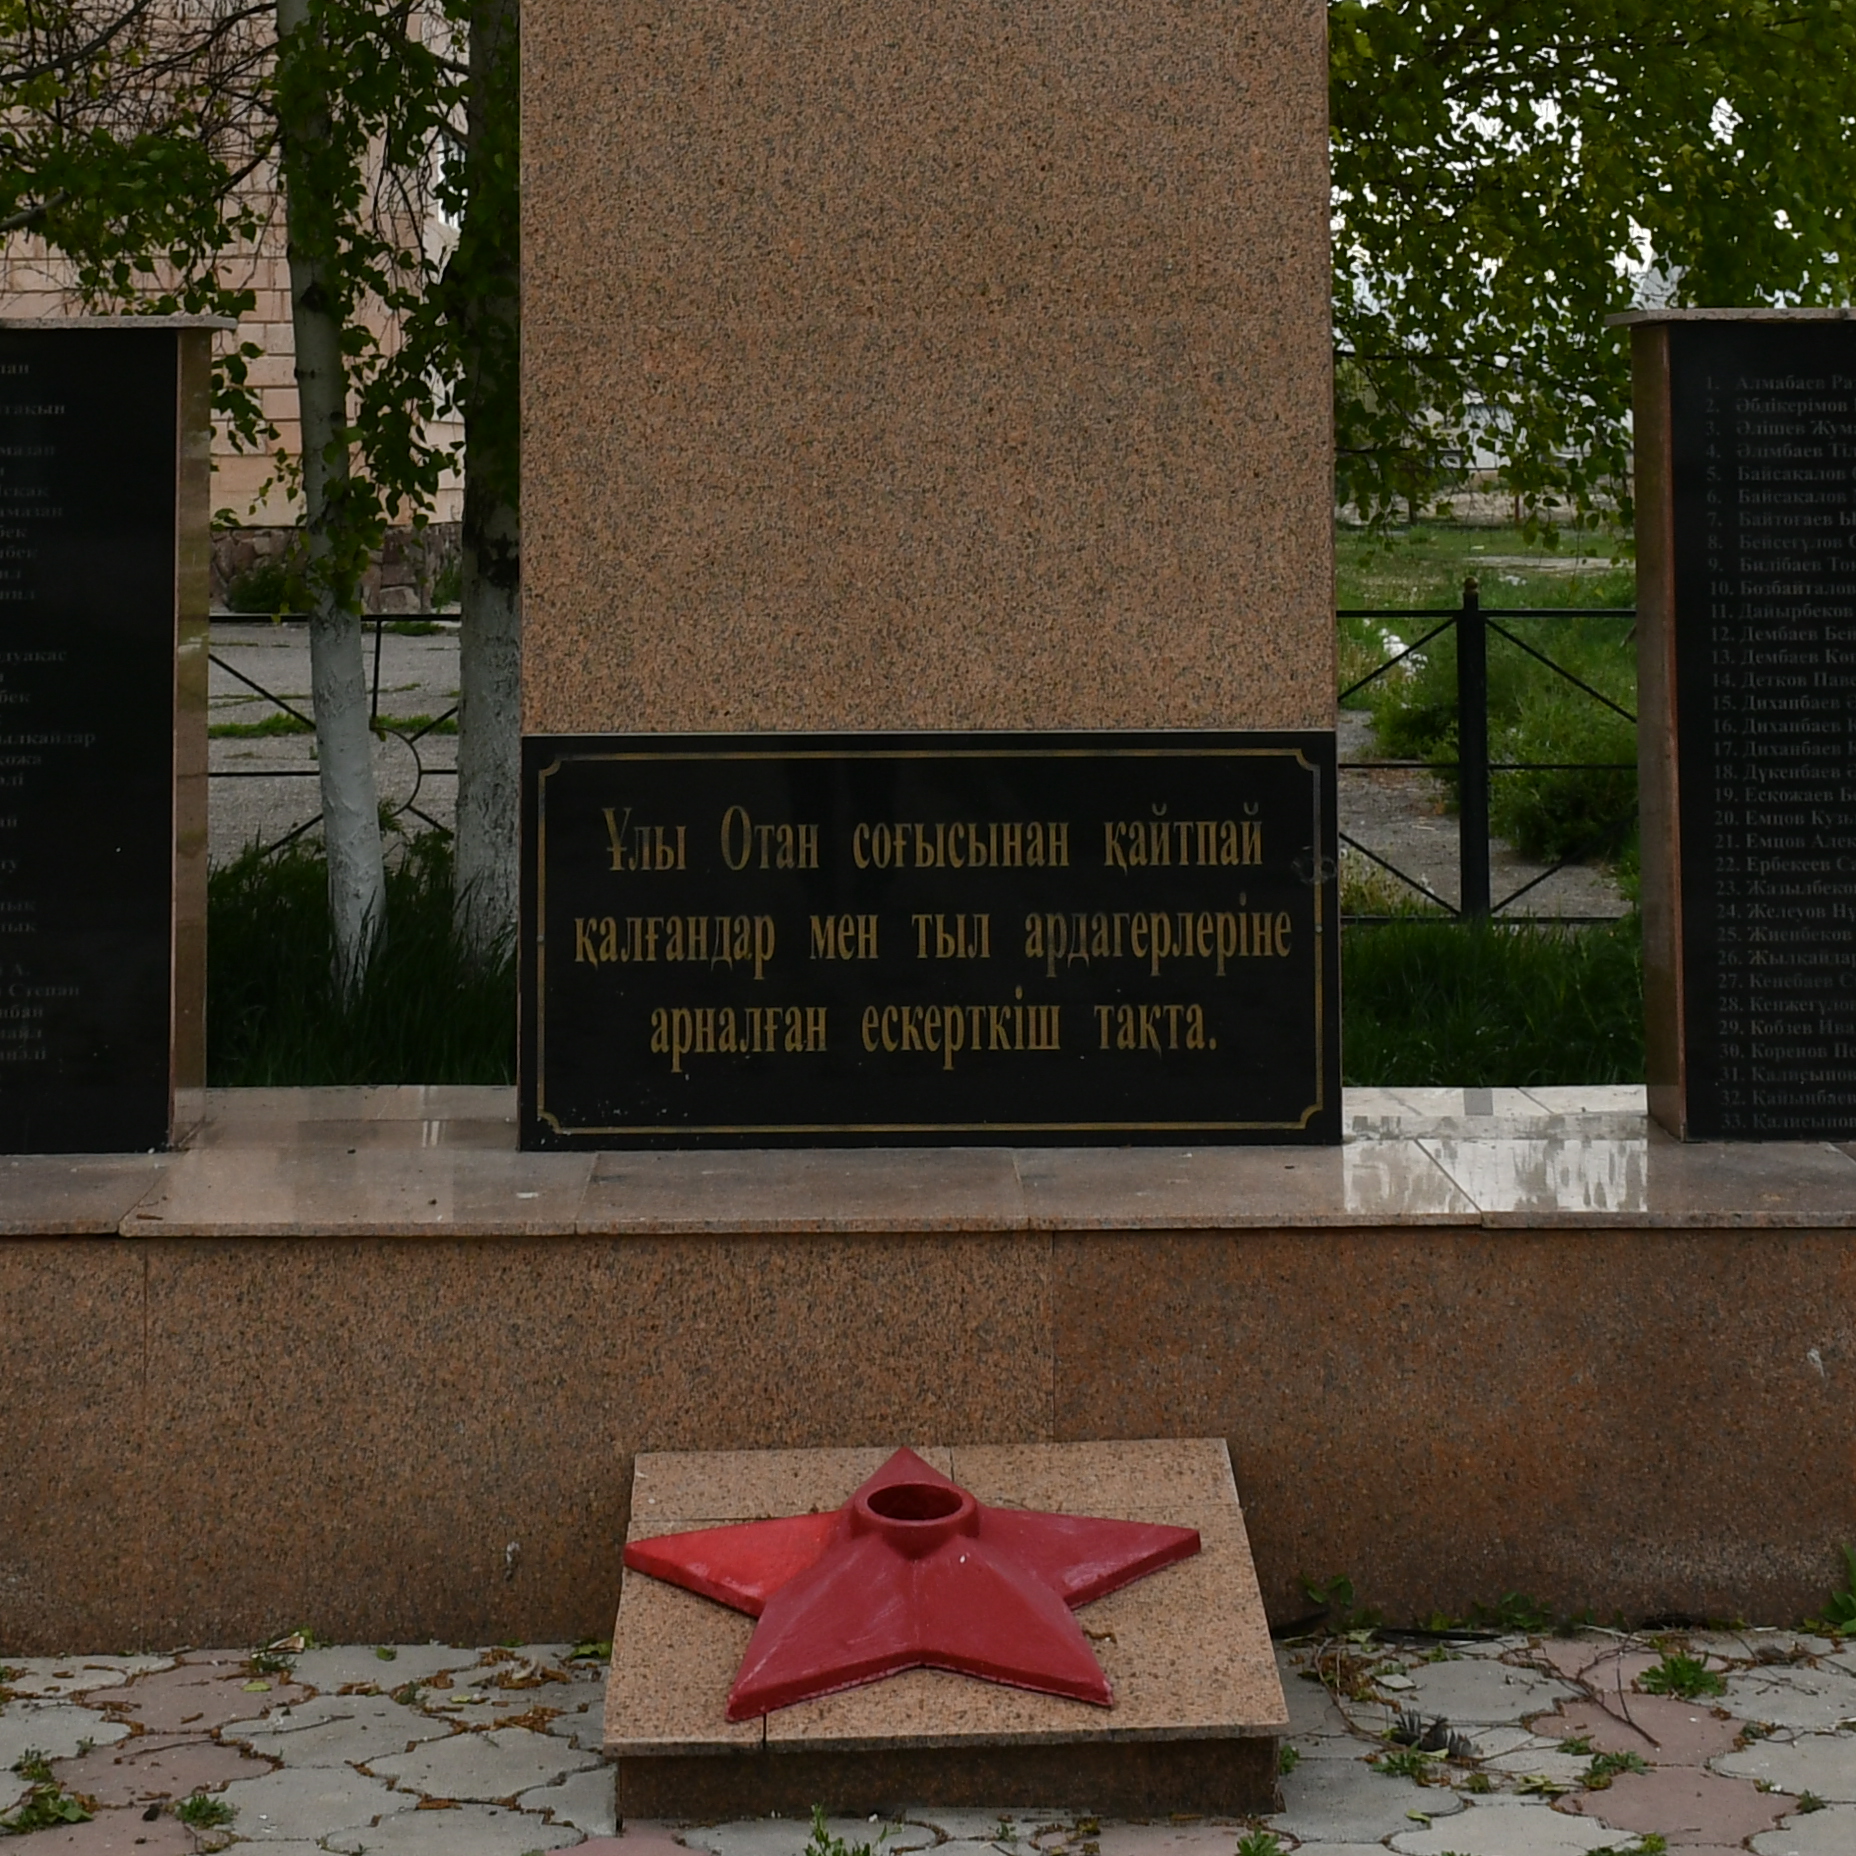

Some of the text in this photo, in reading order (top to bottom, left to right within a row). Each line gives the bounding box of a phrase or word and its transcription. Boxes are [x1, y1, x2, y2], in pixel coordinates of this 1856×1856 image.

[1705, 420, 1720, 436] 3.
[1706, 444, 1721, 458] 4.
[1706, 489, 1722, 504] 6.
[1708, 557, 1724, 572] 9.
[1713, 672, 1736, 687] 14.
[1713, 695, 1736, 710] 15.
[1715, 787, 1738, 802] 19.
[1715, 810, 1739, 826] 20.
[604, 803, 1262, 874] Ұлы Отан соғысынан қайтпай
[1715, 834, 1740, 849] 21.
[1716, 856, 1740, 872] 22.
[575, 896, 1292, 979] қалғандар мен тыл ардагерлеріне
[650, 988, 1218, 1073] арналған ескерткіш тақта.
[1718, 1019, 1744, 1035] 29.
[1719, 1043, 1744, 1058] 30.
